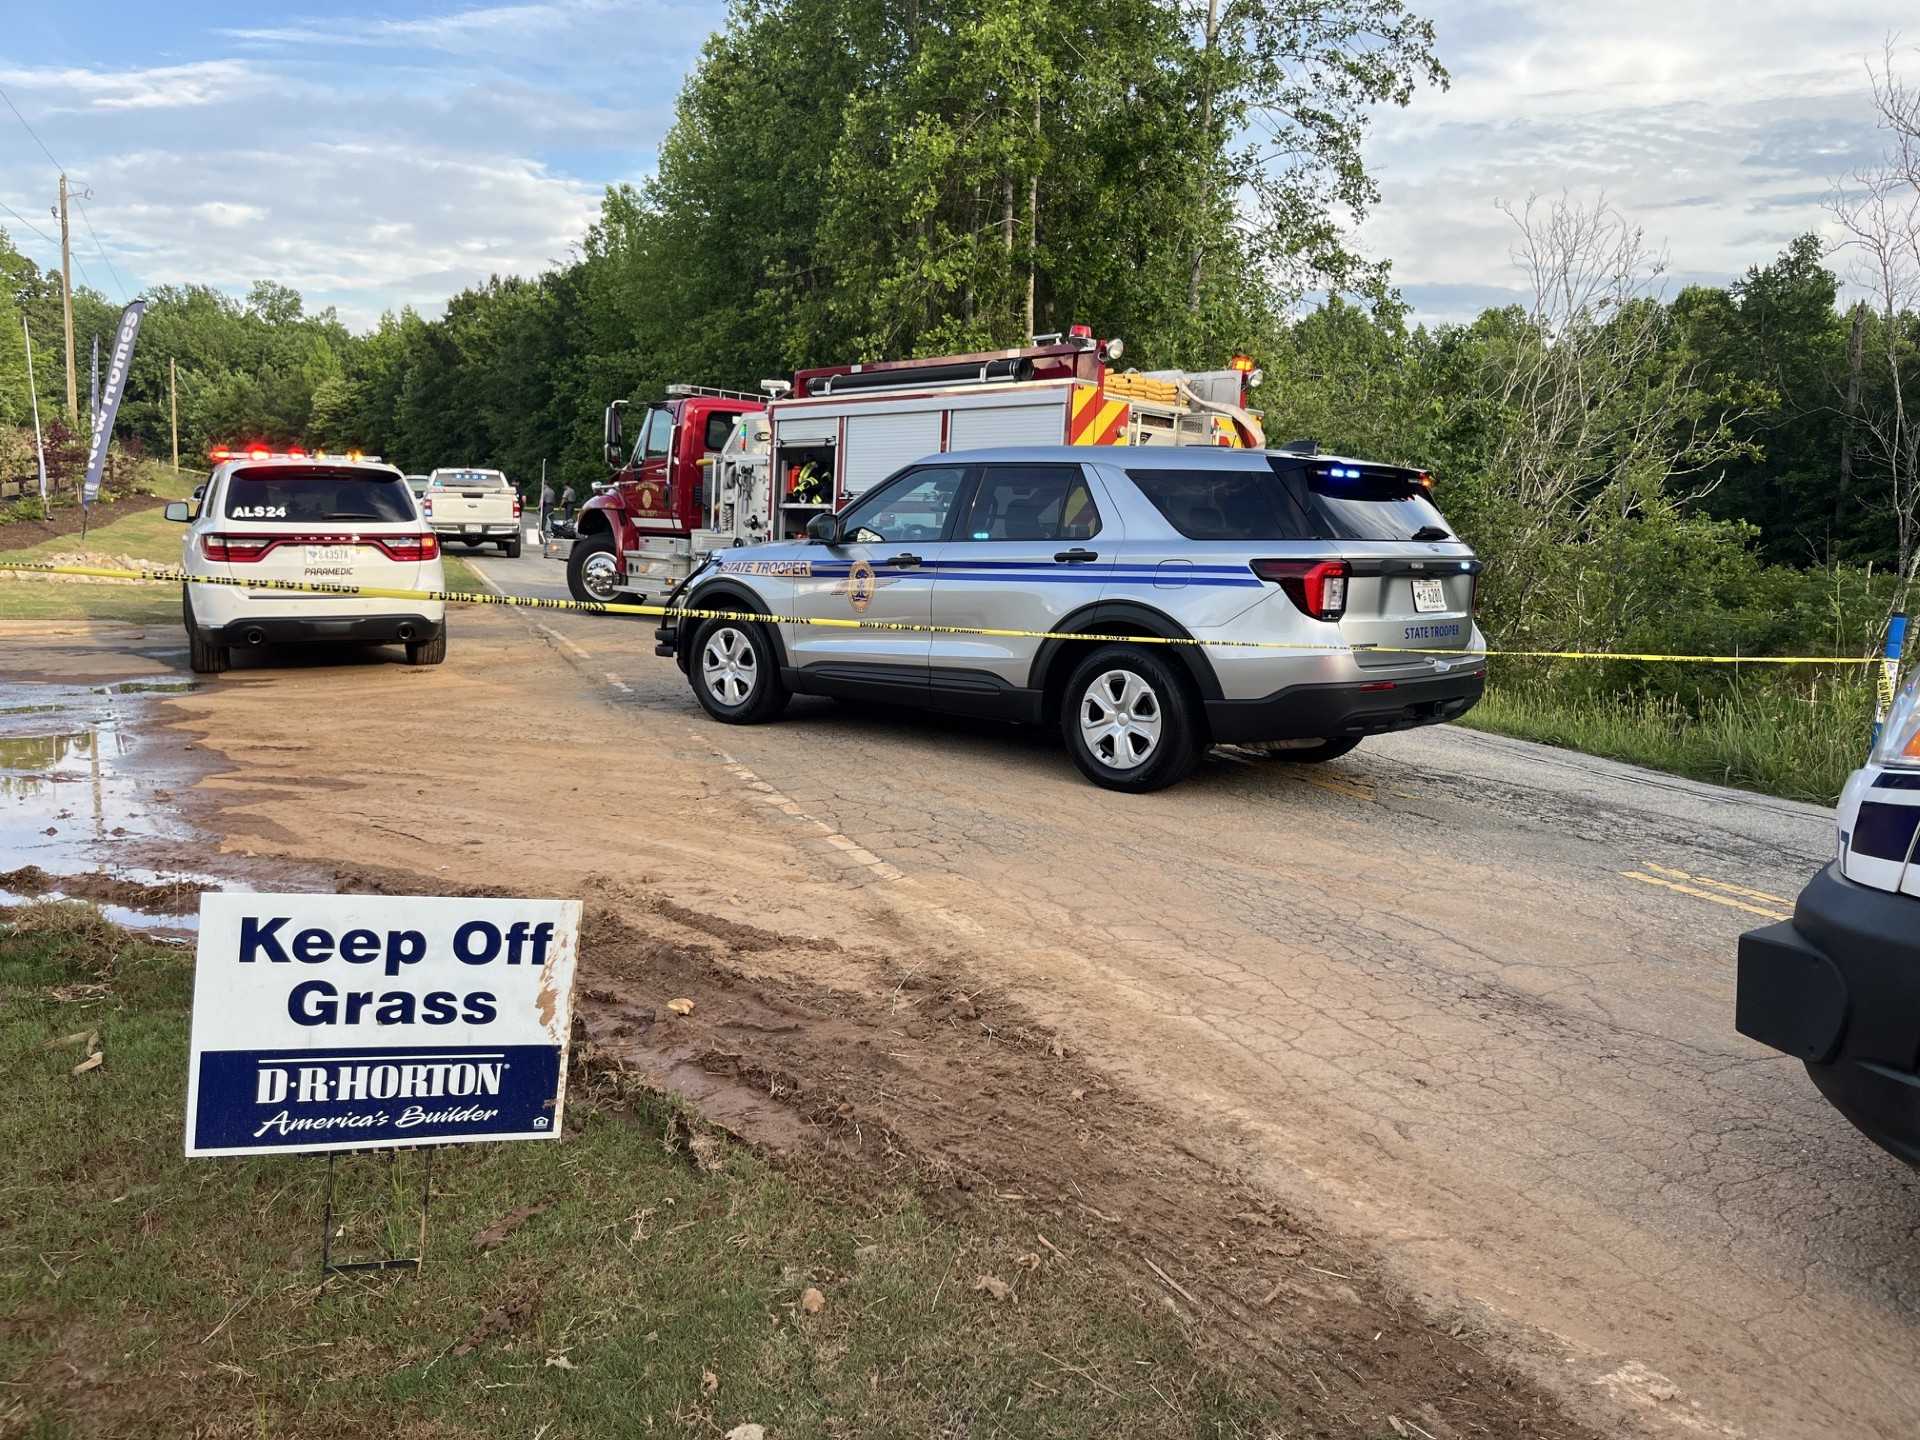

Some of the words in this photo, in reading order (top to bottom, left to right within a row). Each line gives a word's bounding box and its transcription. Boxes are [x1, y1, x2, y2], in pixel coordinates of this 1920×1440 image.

[231, 506, 287, 518] ALS24
[304, 567, 354, 576] PARAMEDIC
[720, 561, 753, 573] STATE
[756, 562, 809, 576] TROOPER
[1404, 626, 1429, 639] STATE
[1431, 624, 1460, 637] TROOPER
[238, 916, 428, 977] Keep
[452, 919, 555, 966] Off
[287, 979, 498, 1027] Grass
[252, 1109, 390, 1138] America's
[394, 1104, 500, 1129] Builder
